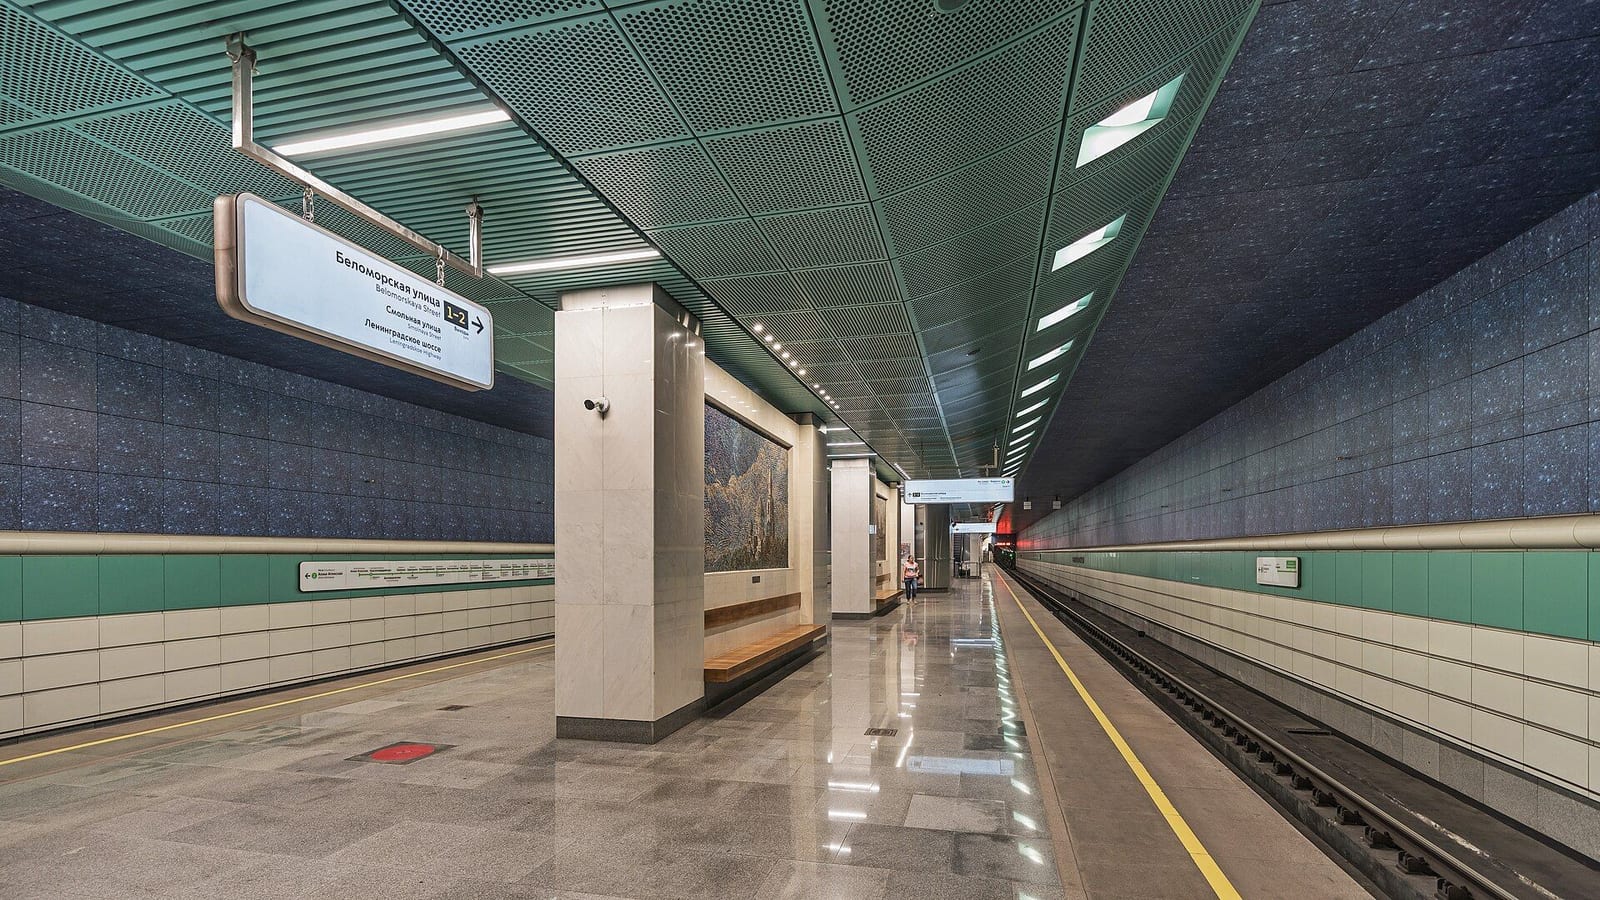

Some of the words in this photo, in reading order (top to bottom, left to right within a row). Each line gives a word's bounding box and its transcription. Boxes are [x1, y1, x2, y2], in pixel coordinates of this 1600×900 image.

[336, 250, 411, 295] Беломорская
[412, 288, 441, 308] улица
[375, 283, 422, 310] Belomorskaya
[423, 304, 441, 318] Street
[364, 318, 421, 346] Ленинградское
[421, 340, 442, 353] шоссе
[386, 305, 421, 325] Смольная
[421, 320, 441, 334] улица
